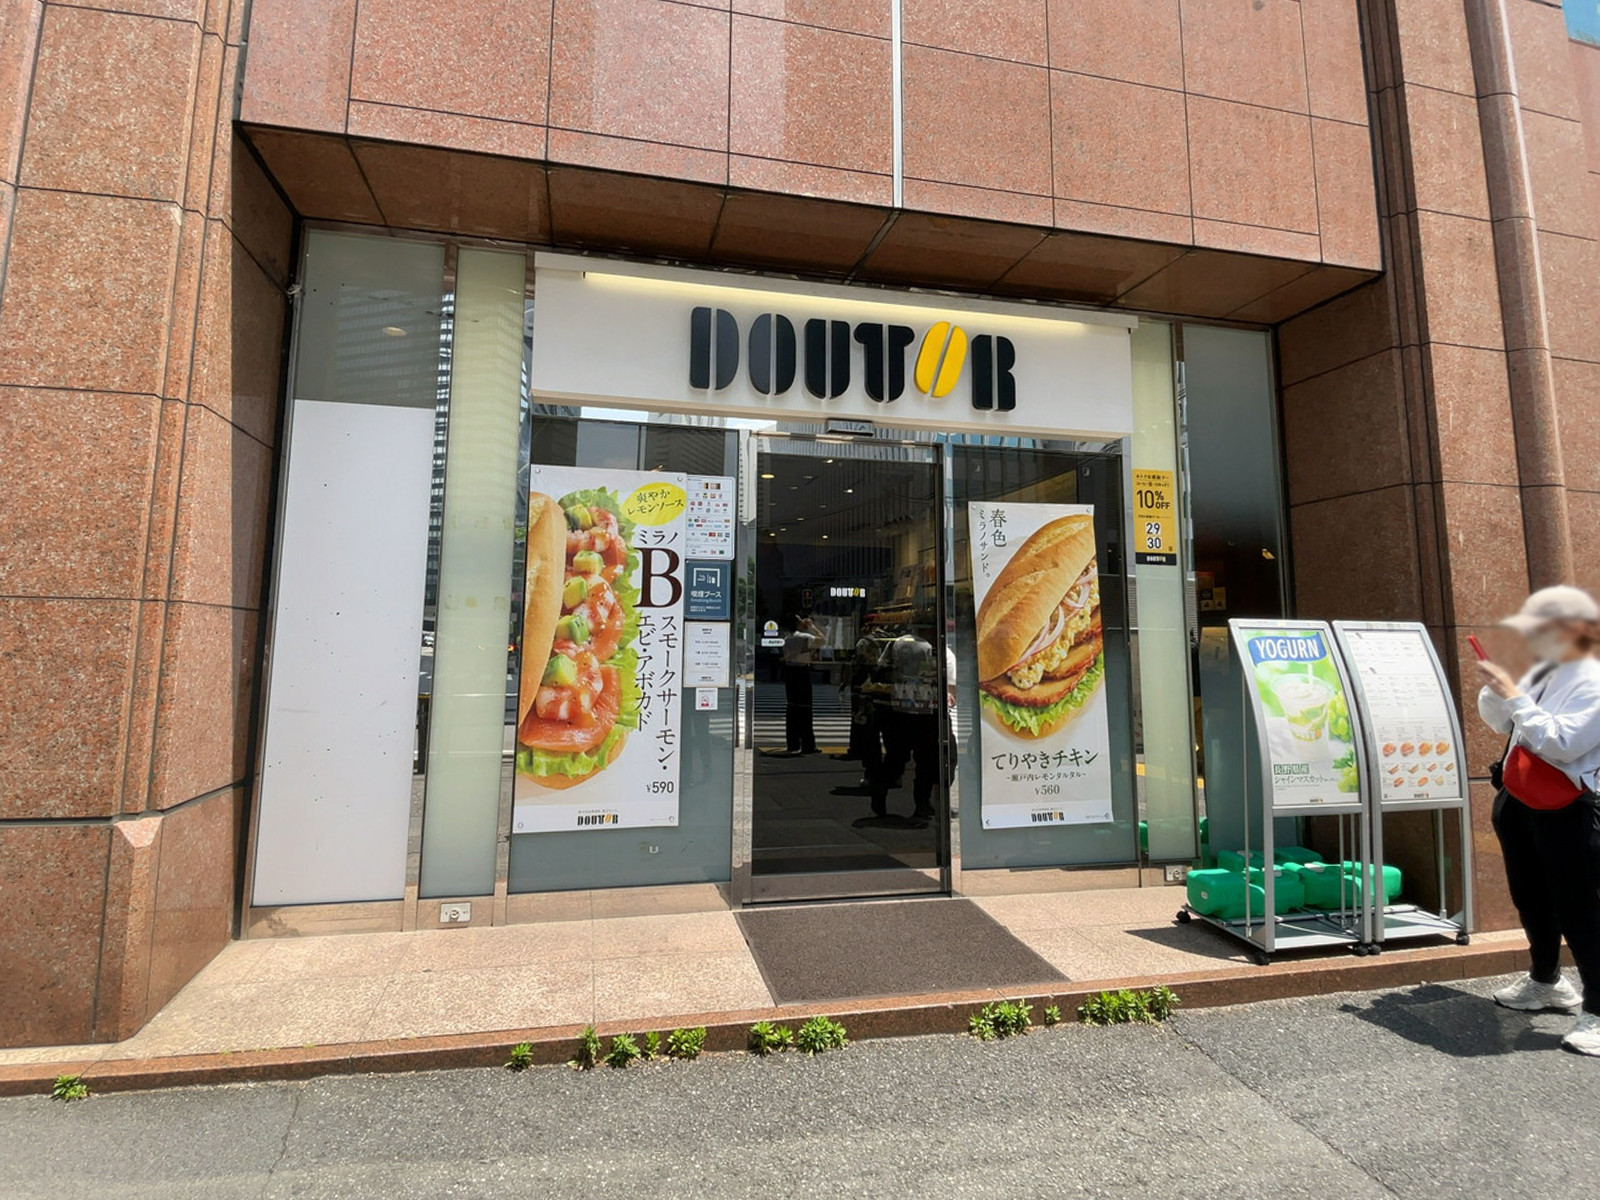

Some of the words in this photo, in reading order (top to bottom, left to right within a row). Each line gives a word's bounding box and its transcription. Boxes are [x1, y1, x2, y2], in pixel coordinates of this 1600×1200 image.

[689, 306, 1016, 412] DOUTOR
[637, 489, 670, 504] 爽やか
[627, 499, 684, 515] レモンソース
[1155, 501, 1170, 509] OFF
[989, 508, 1008, 548] 春色
[1145, 522, 1161, 535] 29
[638, 529, 679, 546] ミラノ
[1146, 537, 1162, 549] 30
[631, 547, 683, 609] B
[830, 587, 866, 598] DOUTOR
[1255, 638, 1320, 659] YOGURN
[634, 614, 657, 732] エビ・アボカド
[991, 748, 1099, 770] てりやきチキン
[646, 781, 675, 794] ¥590
[577, 813, 619, 826] DOUTOR
[1031, 811, 1065, 822] DOUTOR
